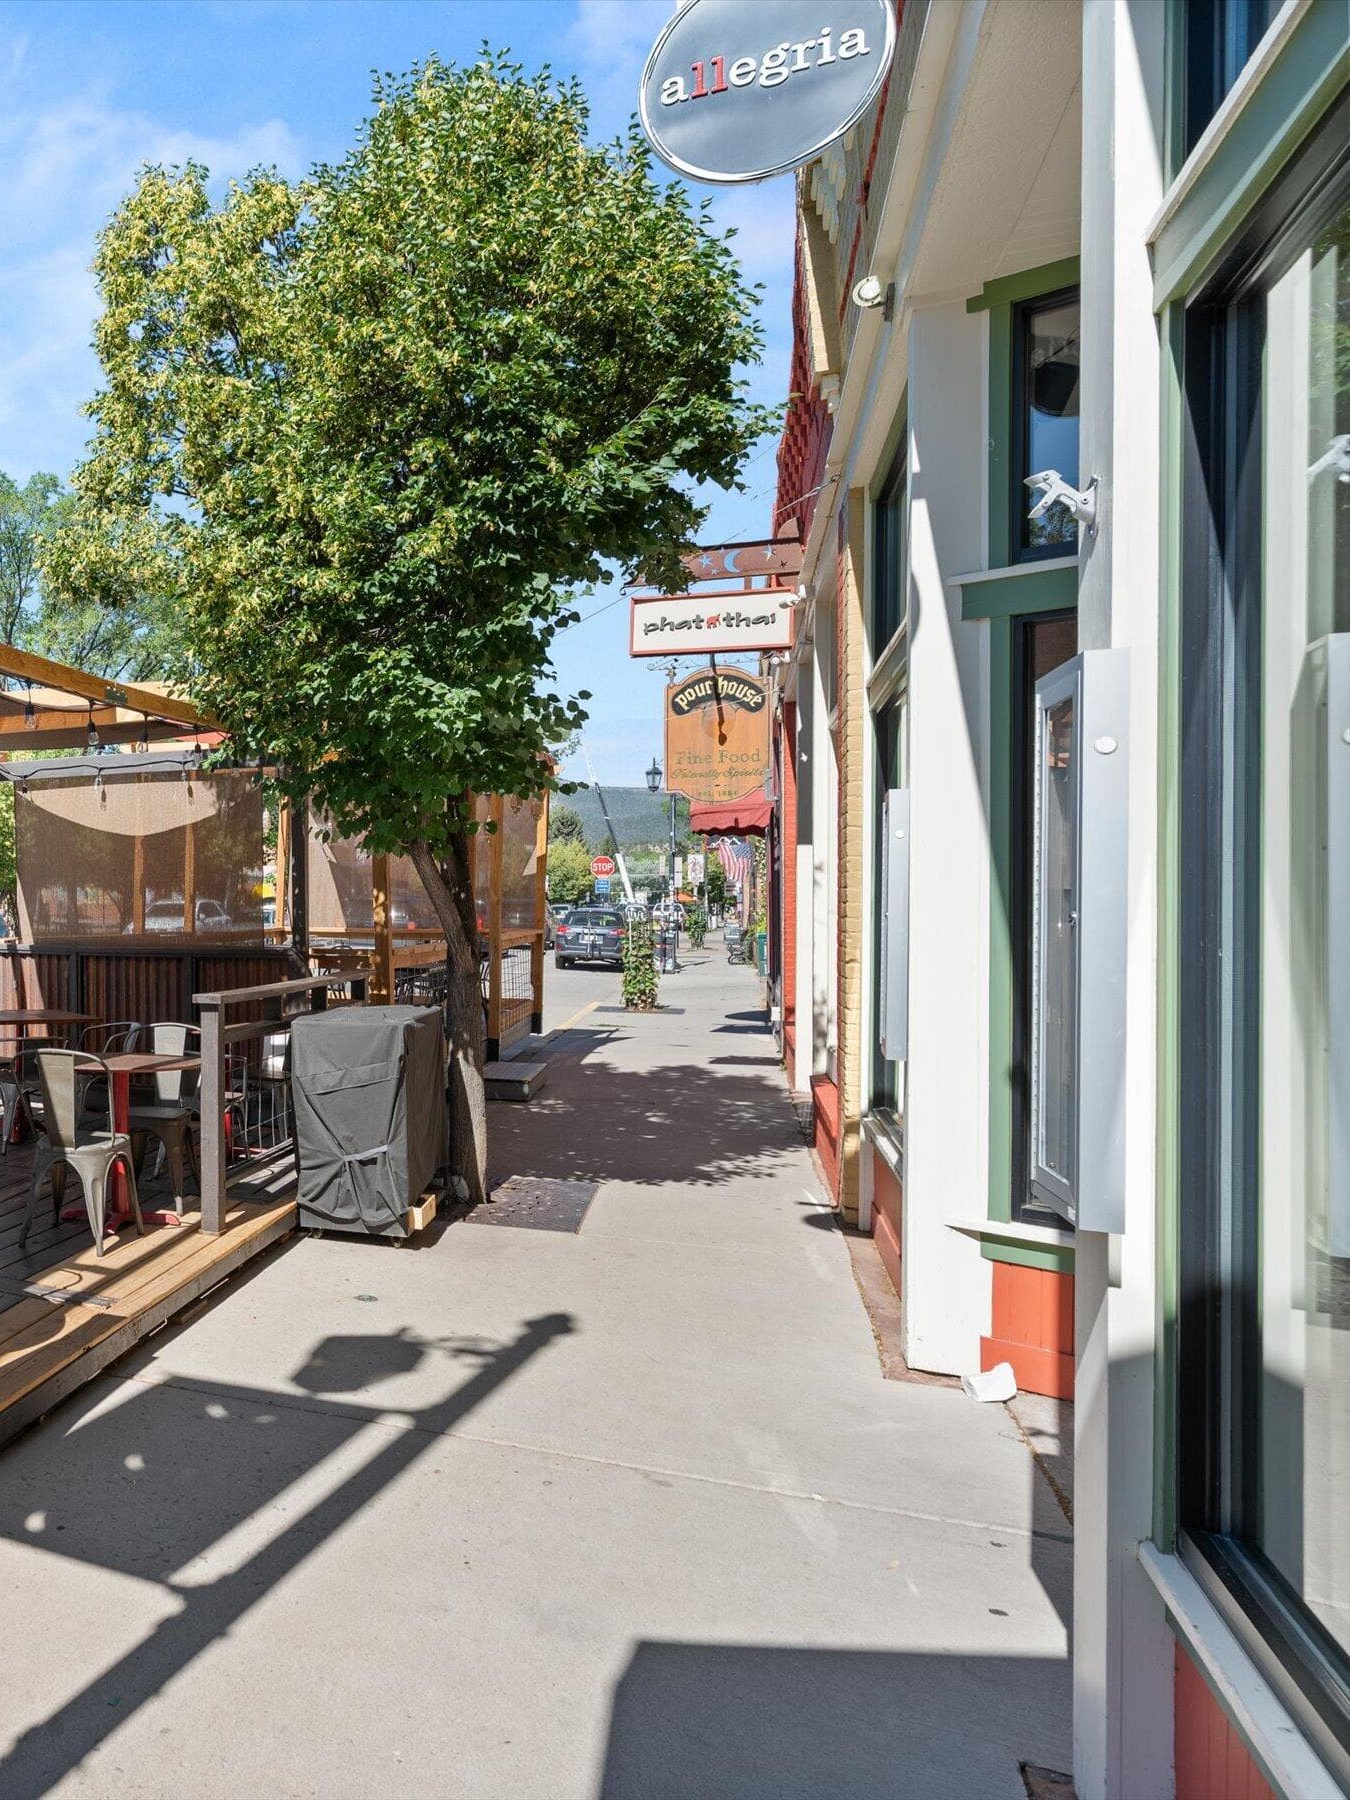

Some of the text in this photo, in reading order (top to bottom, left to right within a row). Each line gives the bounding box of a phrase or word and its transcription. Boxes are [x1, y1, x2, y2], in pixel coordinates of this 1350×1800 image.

[660, 26, 871, 106] allegria
[643, 611, 776, 636] phat thai
[675, 675, 762, 711] pour house
[675, 748, 761, 765] Fine Food
[592, 862, 613, 872] STOP
